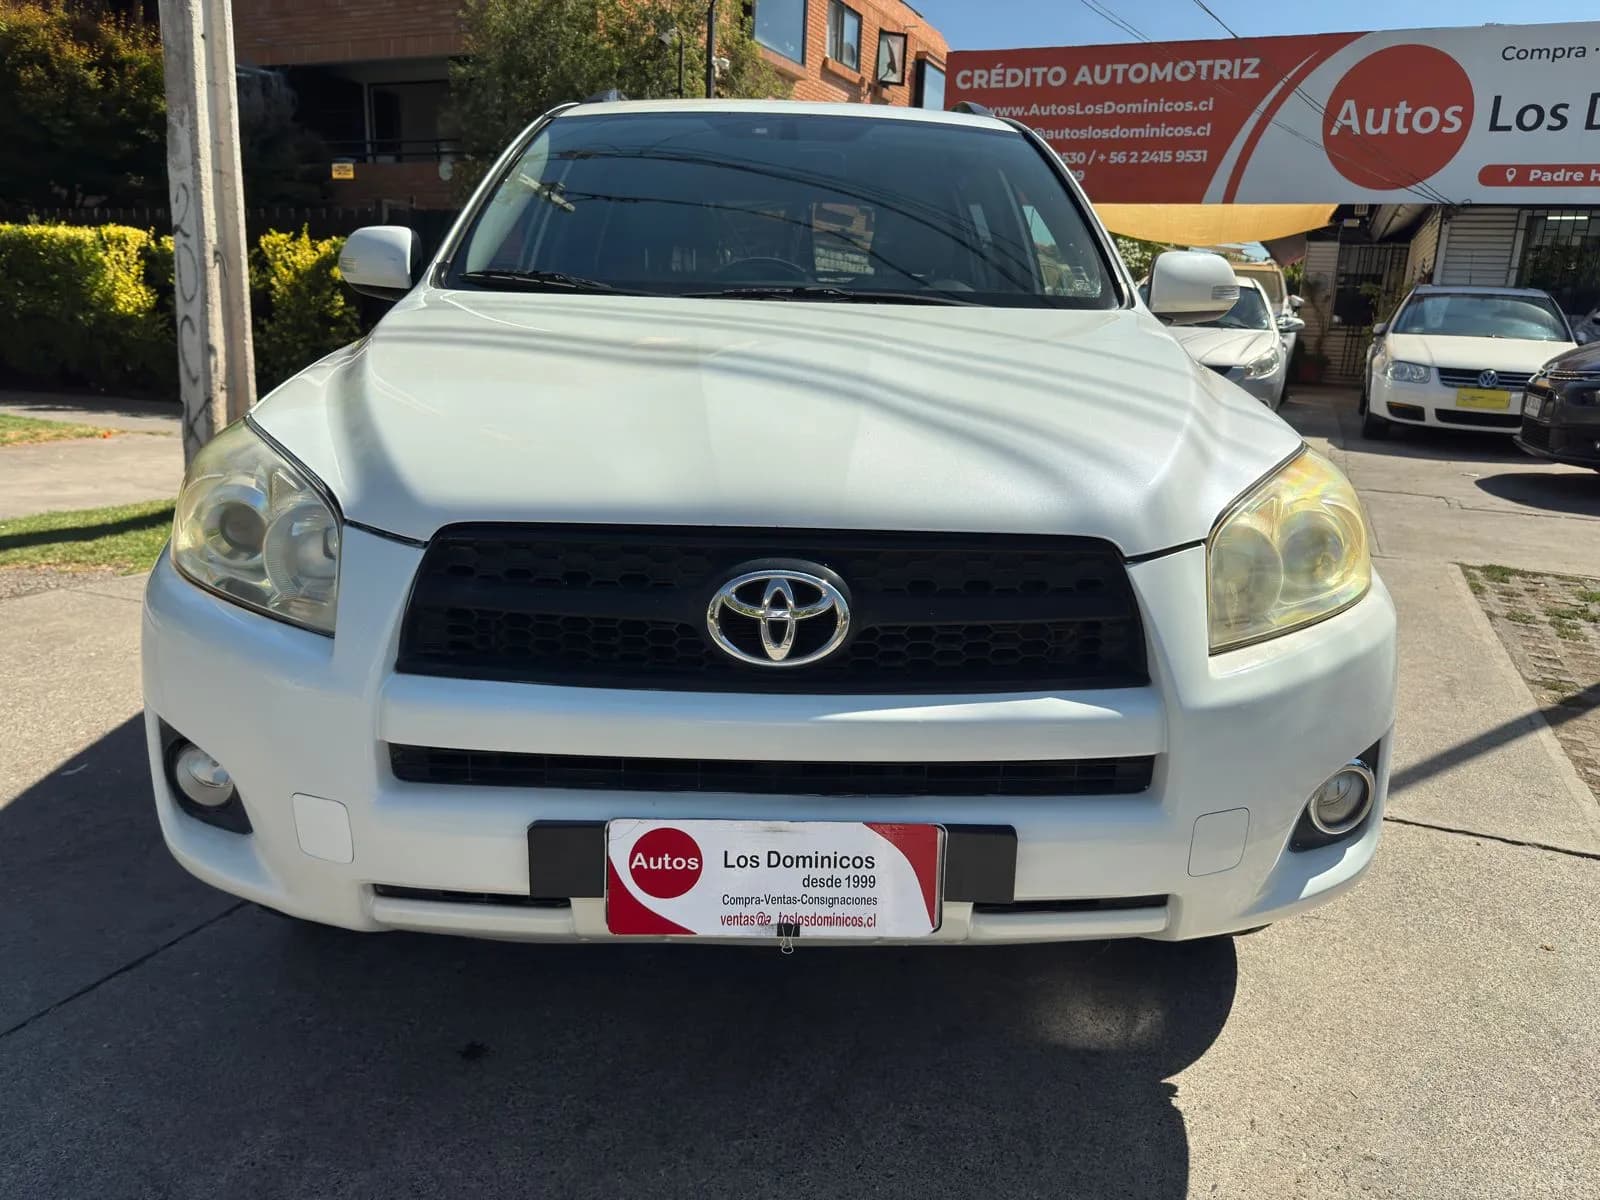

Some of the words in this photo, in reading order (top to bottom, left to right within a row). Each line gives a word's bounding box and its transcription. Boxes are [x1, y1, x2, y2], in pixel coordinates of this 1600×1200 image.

[1501, 46, 1587, 63] Compra
[956, 64, 1067, 90] CRÉDITO
[1073, 58, 1260, 87] AUTOMOTRIZ
[988, 97, 1214, 117] www.AutosLosDominicos.cl
[1330, 99, 1463, 136] Autos
[1488, 95, 1570, 132] Los
[1108, 151, 1127, 164] 56
[1129, 151, 1138, 163] 2
[1140, 150, 1172, 163] 2415
[1175, 150, 1208, 163] 9531
[1529, 169, 1584, 182] Padre
[631, 852, 699, 870] Autos
[723, 850, 760, 869] Los
[767, 850, 876, 869] Dominicos
[802, 874, 842, 888] desde
[845, 874, 876, 888] 1999
[722, 894, 878, 907] Compra-Ventas-Consignaciones
[720, 911, 877, 928] ventas@atoslosdominicos.cl
